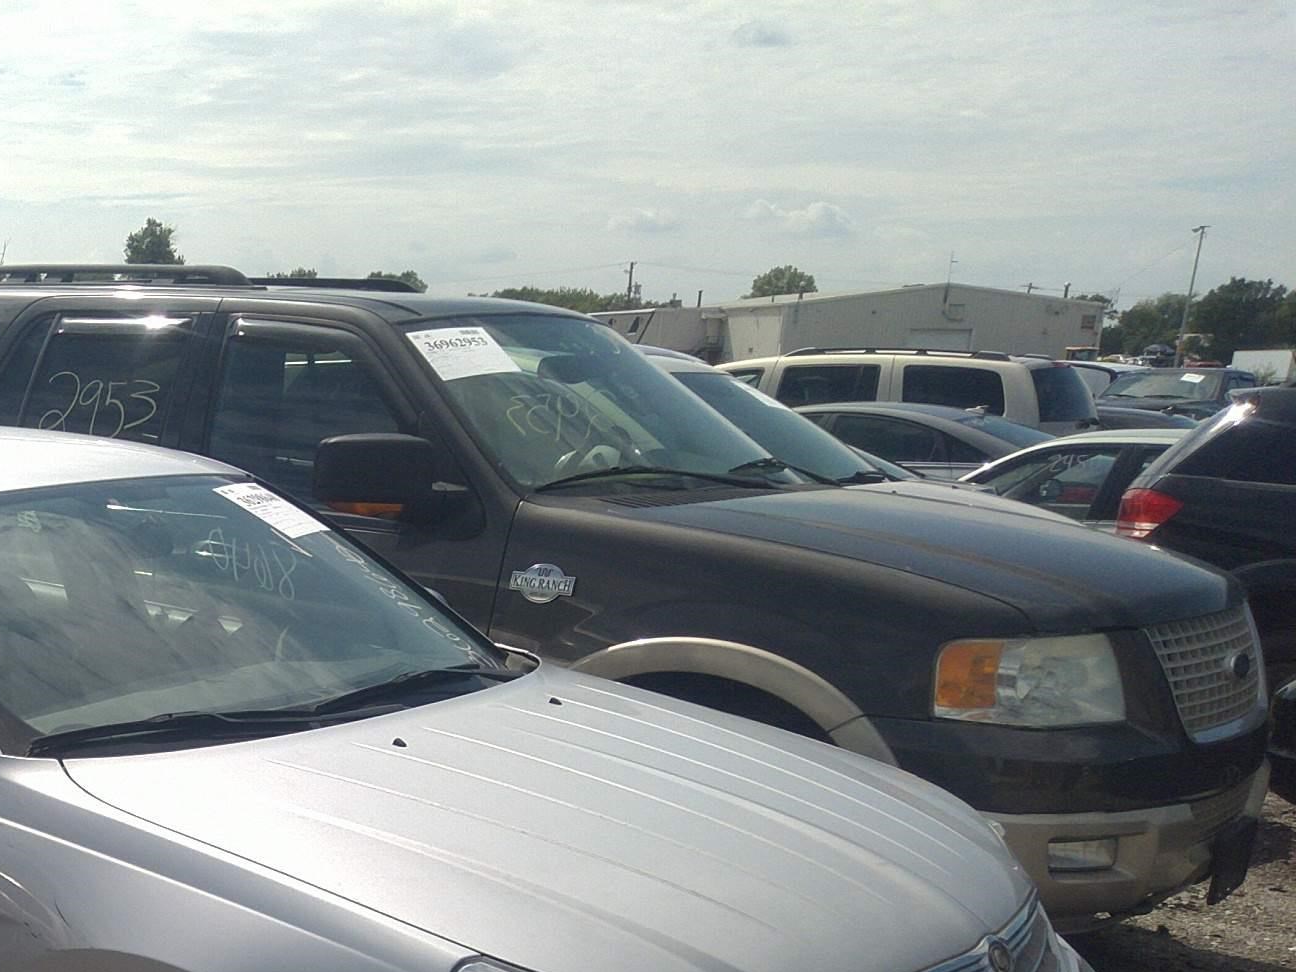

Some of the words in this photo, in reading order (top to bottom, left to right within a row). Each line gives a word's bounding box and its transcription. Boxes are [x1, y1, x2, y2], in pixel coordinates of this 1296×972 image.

[424, 337, 488, 352] 36962953
[39, 371, 161, 439] 2953
[512, 574, 537, 589] KING
[538, 578, 572, 592] RANCH
